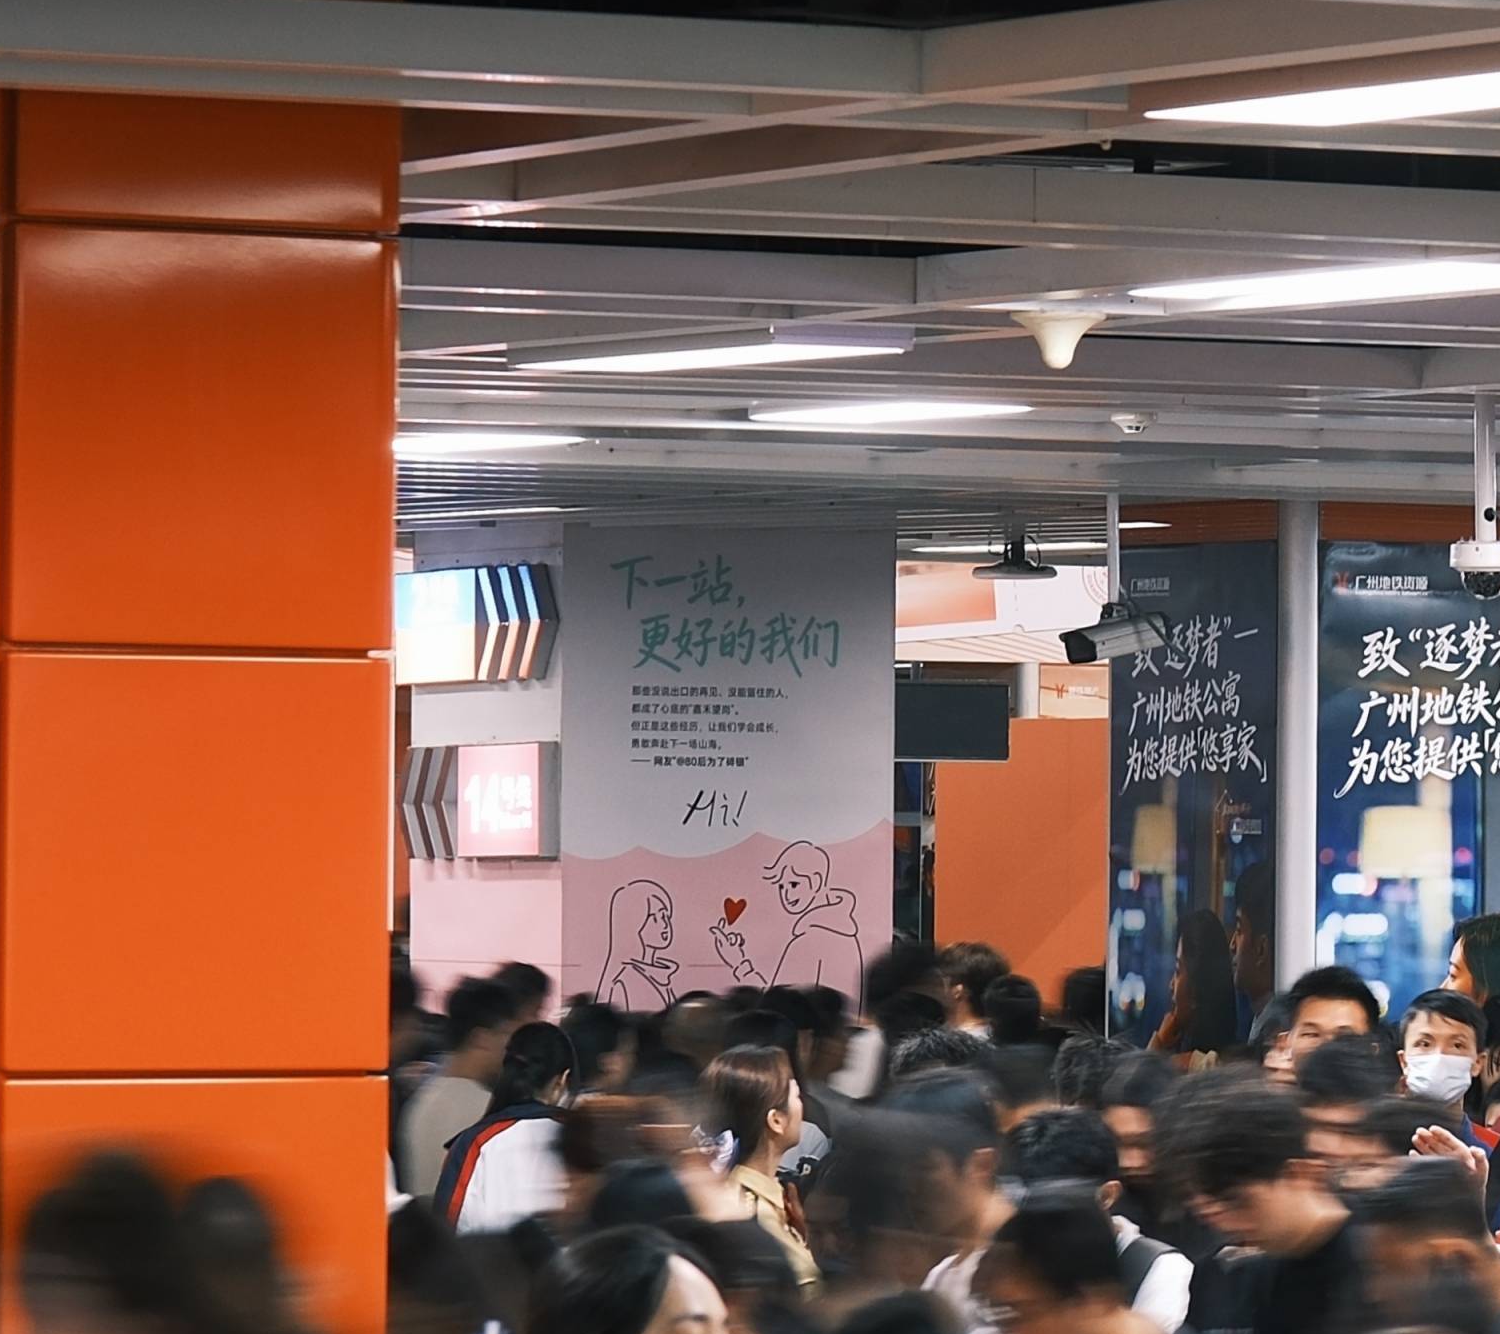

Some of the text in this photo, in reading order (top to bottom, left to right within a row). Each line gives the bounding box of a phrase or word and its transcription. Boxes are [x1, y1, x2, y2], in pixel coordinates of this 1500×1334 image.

[632, 612, 840, 679] 更好的我们
[1128, 671, 1241, 736] 广州地铁公寓
[682, 790, 747, 826] Hi!
